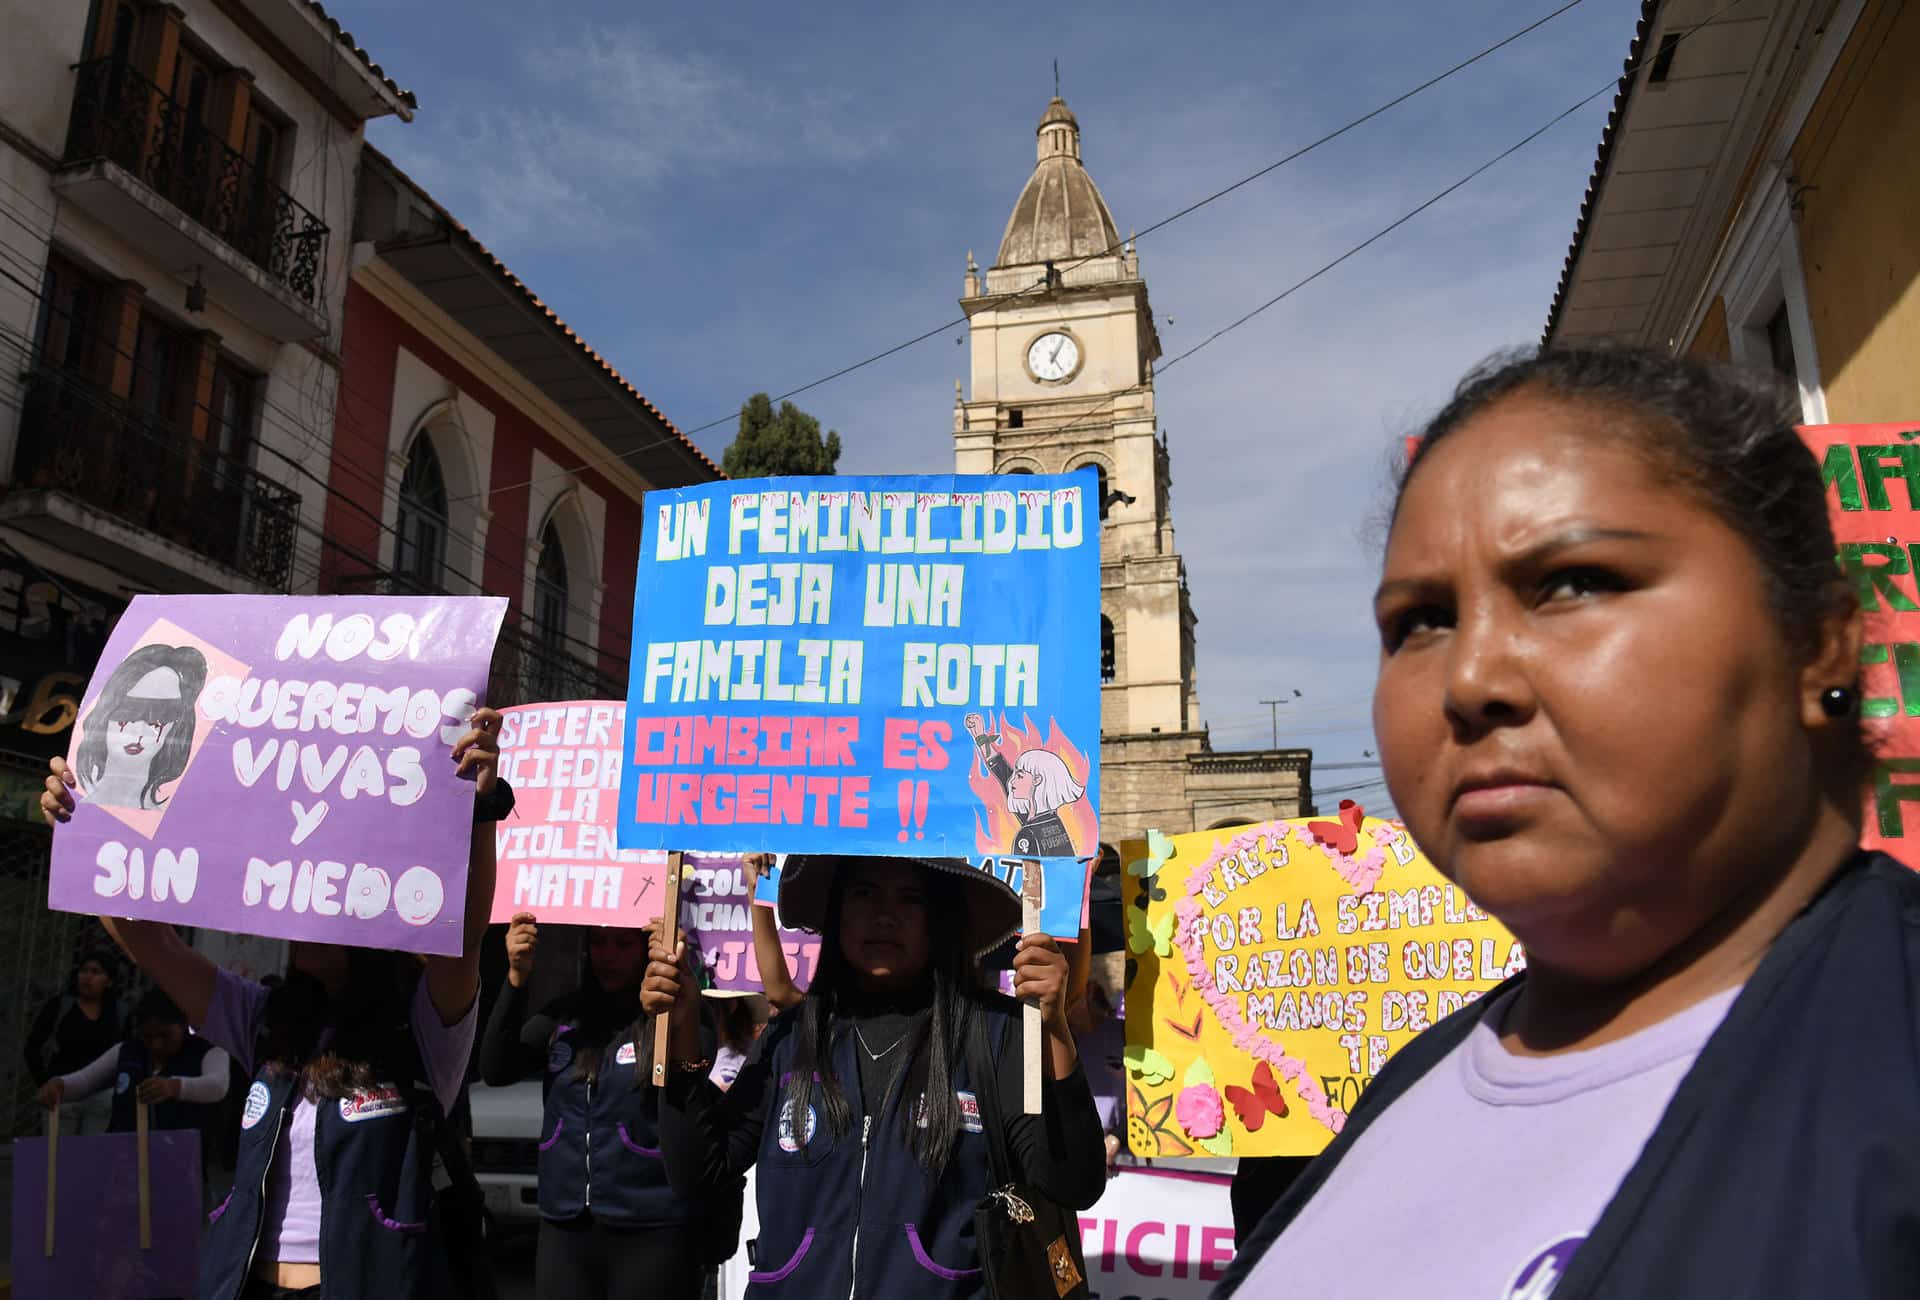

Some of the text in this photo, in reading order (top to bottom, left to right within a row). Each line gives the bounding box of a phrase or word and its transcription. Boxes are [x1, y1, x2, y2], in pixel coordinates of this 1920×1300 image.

[656, 486, 1083, 561] UN FEMINICIDIO
[704, 563, 965, 627] DEJA UNA
[643, 639, 1039, 707] FAMILIA ROTA
[199, 675, 478, 746] QUEREMOS
[232, 738, 428, 806] VIVAS
[633, 716, 952, 770] CAMBIAR ES
[290, 800, 329, 845] Y
[546, 786, 600, 822] LA
[635, 774, 930, 842] URGENTE !!
[94, 841, 199, 903] SIN
[496, 824, 668, 865] VIOLEN
[1201, 836, 1290, 909] ERES
[243, 857, 444, 925] MIEDO
[513, 863, 624, 909] MATA
[1189, 906, 1264, 953] POR
[1276, 897, 1321, 941] LA
[1215, 946, 1339, 995] RAZON
[1345, 941, 1390, 985] DE
[1480, 938, 1528, 980] LA
[1246, 990, 1369, 1033] MANOS
[1381, 990, 1432, 1032] DE
[1338, 1034, 1390, 1076] TE
